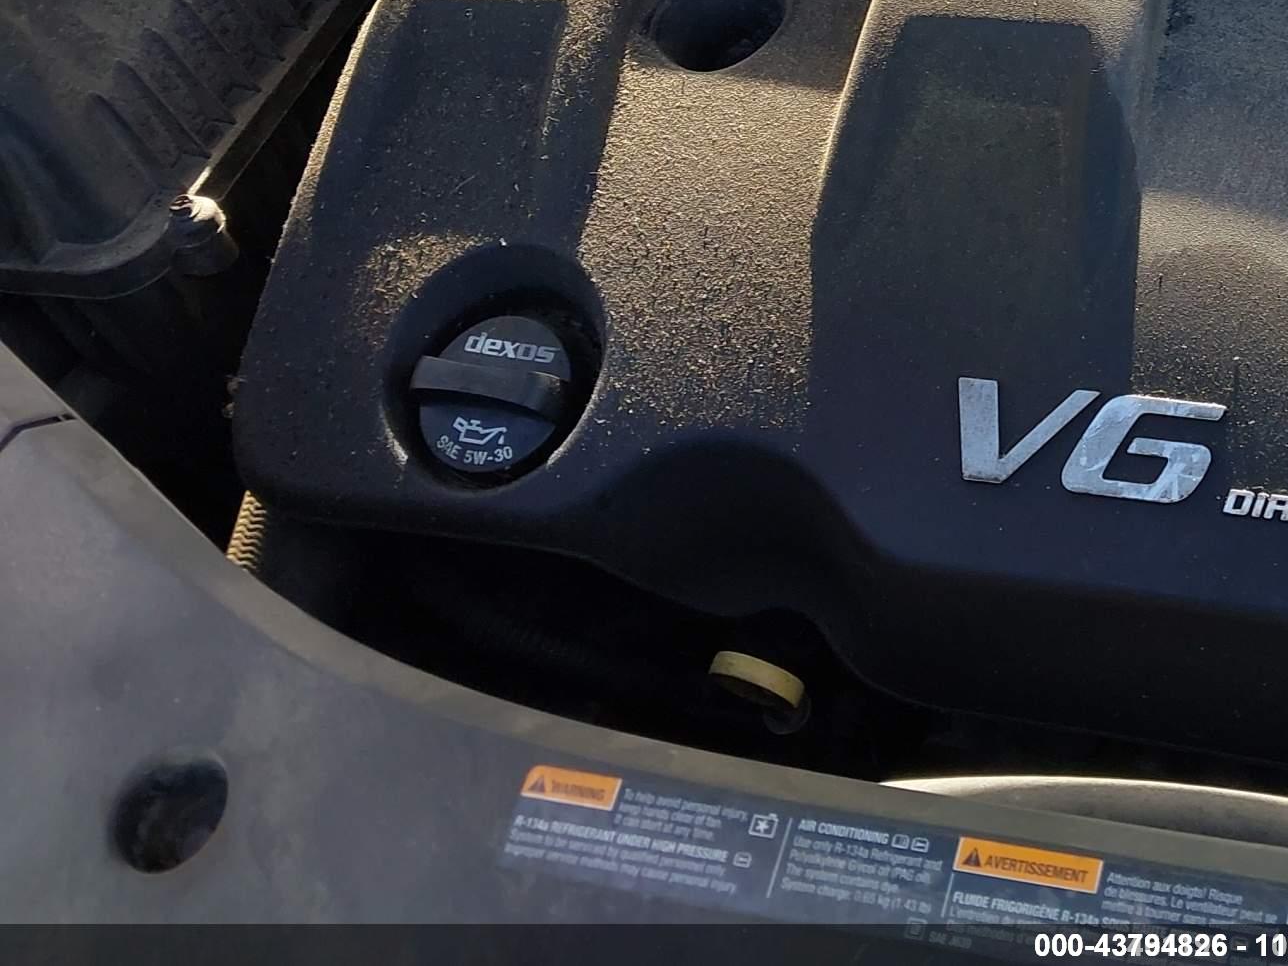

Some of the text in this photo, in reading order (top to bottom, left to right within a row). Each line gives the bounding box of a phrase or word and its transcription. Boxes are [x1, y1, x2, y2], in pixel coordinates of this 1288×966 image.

[464, 332, 561, 363] dexos
[436, 435, 513, 466] SAE 5W-30
[957, 376, 1227, 506] V6
[551, 779, 606, 802] WARNING
[513, 814, 729, 862] R-134a REFRIGERANT UNDER HIGH PRESSURE
[798, 819, 891, 845] AIR CONDITIONING
[833, 841, 870, 859] R-134a
[984, 854, 1089, 883] AVERTISSEMENT
[781, 876, 816, 893] System
[1104, 886, 1119, 898] de
[1170, 896, 1185, 909] Le
[1107, 872, 1151, 891] Attention
[1152, 880, 1172, 893] aux
[1208, 888, 1243, 905] Risque
[952, 890, 991, 909] FLUIDE
[990, 897, 1060, 921] FRIGORIGÈNE
[1060, 909, 1100, 927] R-134a
